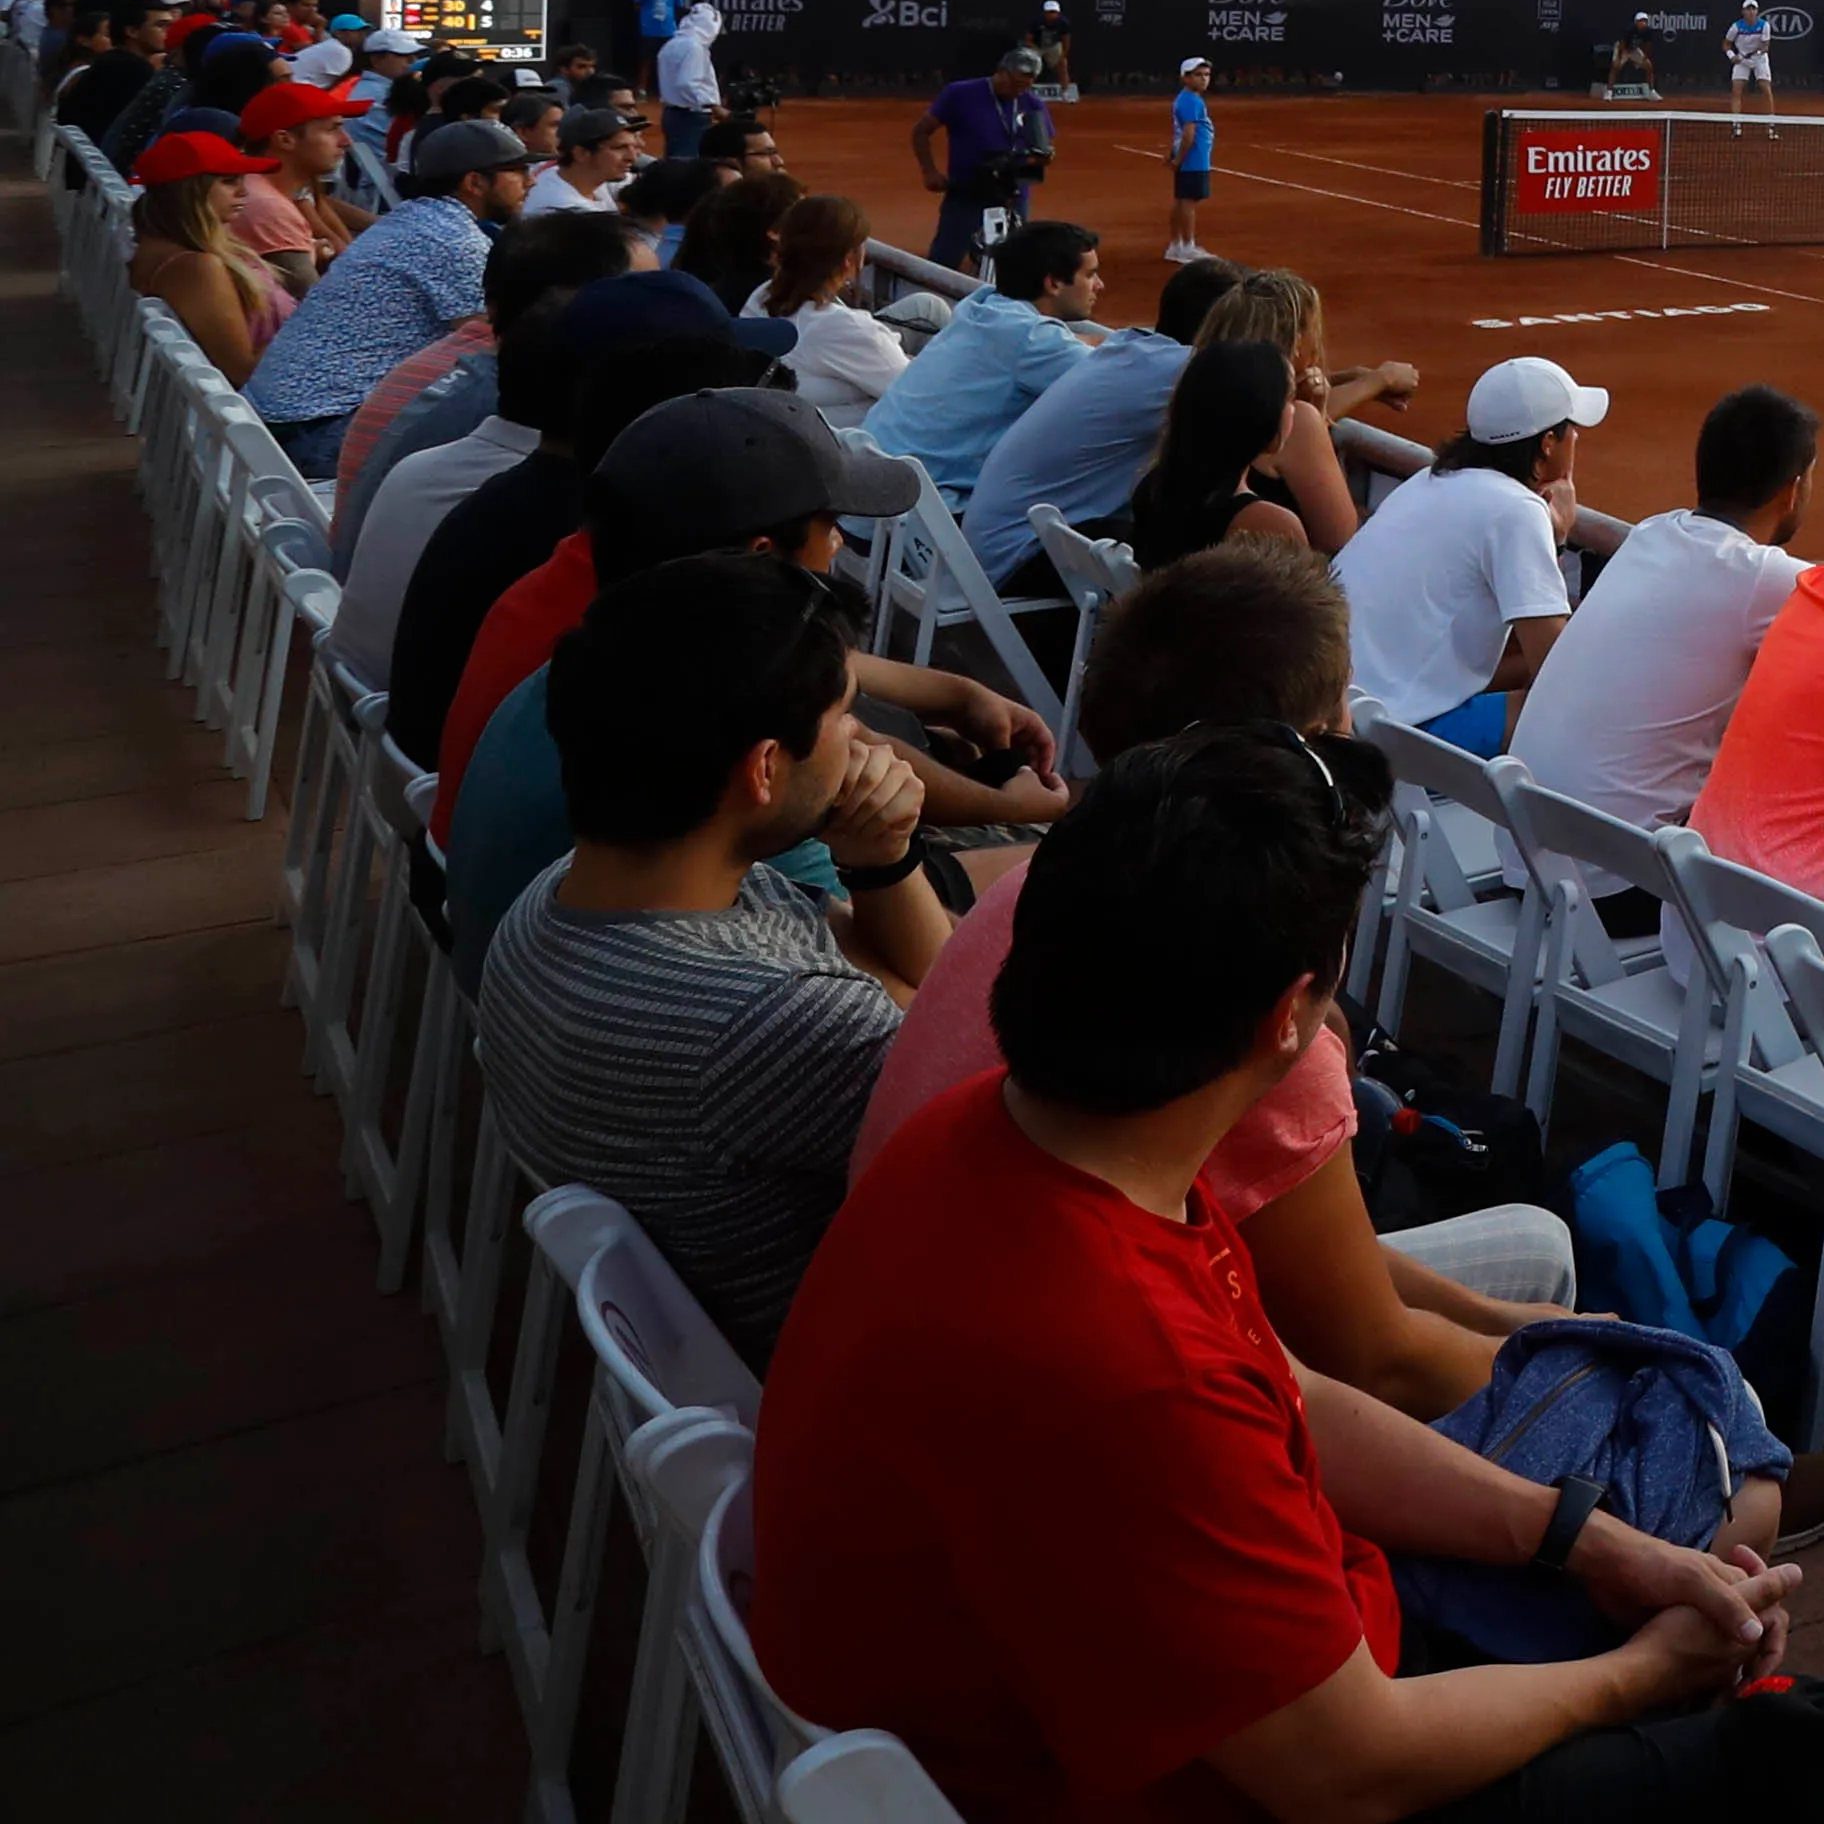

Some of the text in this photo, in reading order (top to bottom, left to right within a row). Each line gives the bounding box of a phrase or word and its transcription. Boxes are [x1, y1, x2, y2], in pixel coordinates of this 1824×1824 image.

[480, 0, 494, 13] 4
[899, 0, 948, 27] Bci
[480, 15, 493, 28] 5
[1208, 10, 1260, 25] MEN
[1383, 13, 1431, 28] MEN
[1766, 14, 1803, 32] KIA
[1207, 26, 1285, 41] +CARE
[1382, 29, 1453, 43] +CARE
[1527, 144, 1650, 174] Emirates
[1545, 175, 1632, 199] FLY BETTER
[1471, 302, 1771, 329] SANTIAGO
